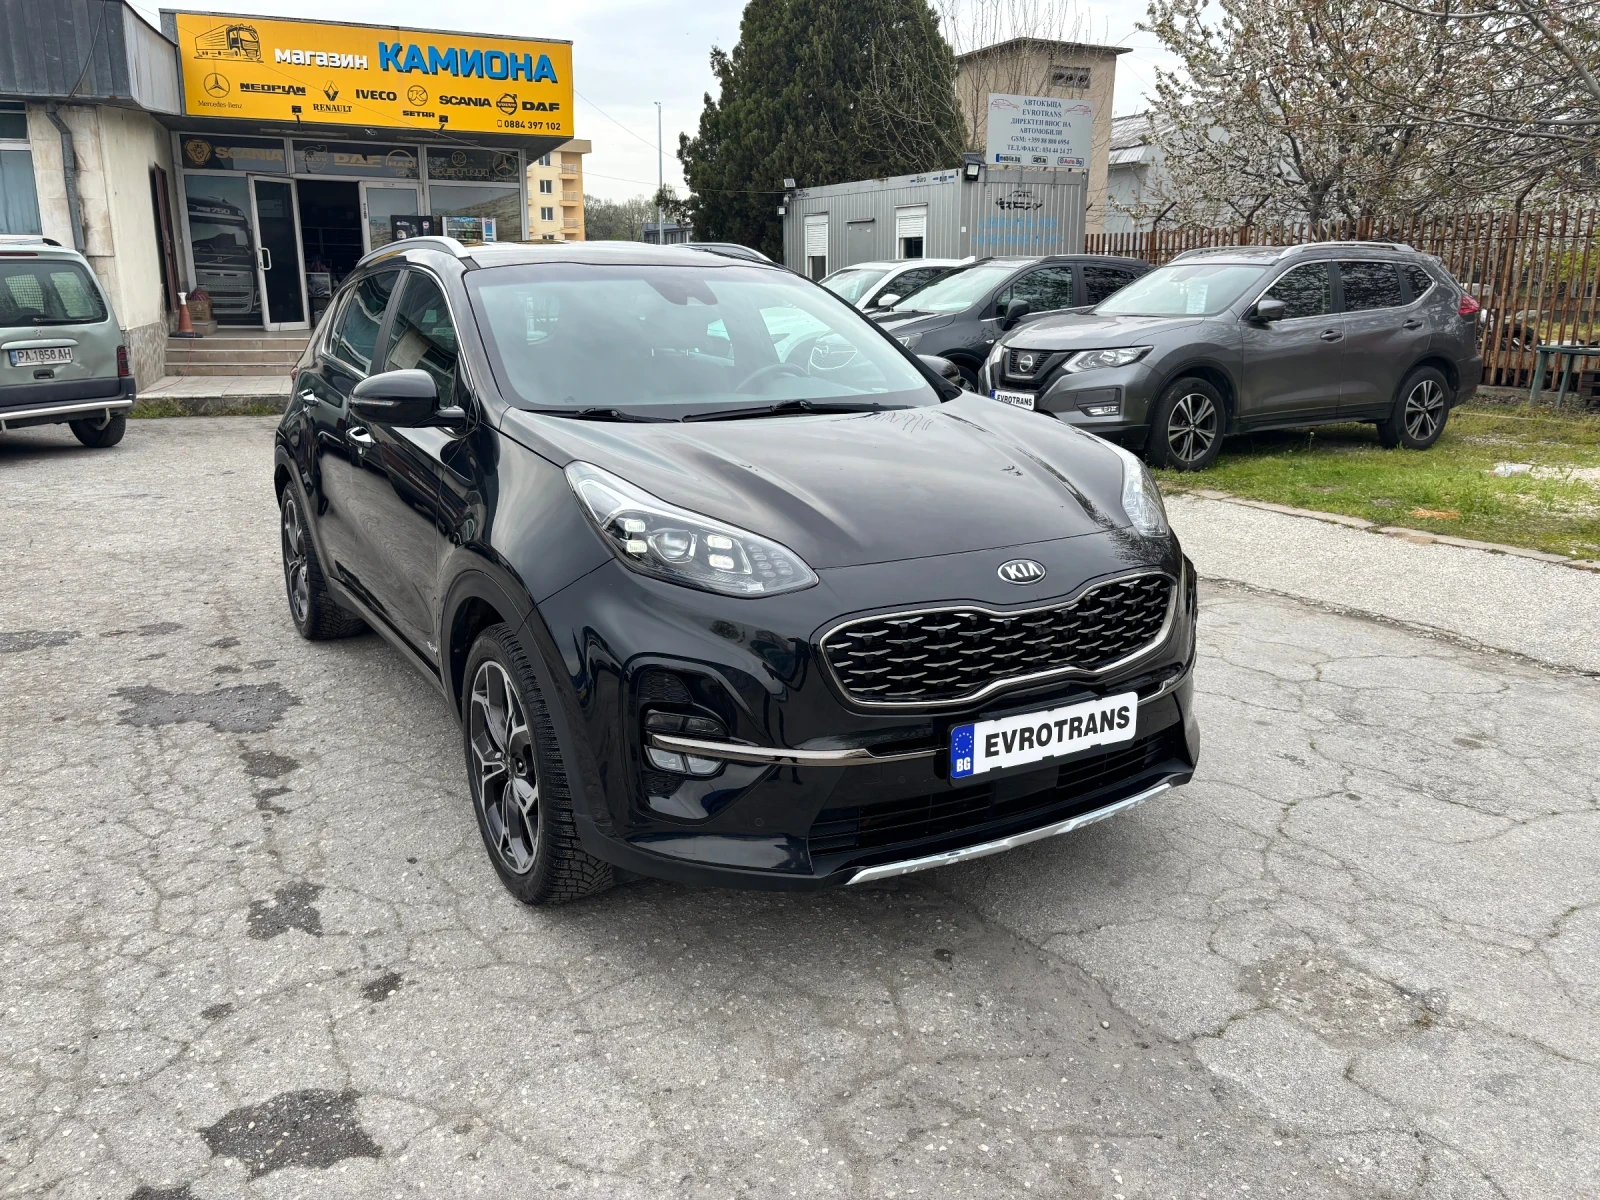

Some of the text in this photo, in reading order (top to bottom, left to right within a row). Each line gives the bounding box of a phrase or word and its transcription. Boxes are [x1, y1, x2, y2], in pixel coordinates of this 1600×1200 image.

[274, 41, 557, 82] магазин КАМИОНА
[240, 82, 306, 95] NEOPLAN
[356, 89, 397, 101] IVECO
[198, 100, 242, 109] Mercedes-Benz
[439, 95, 492, 107] SCANIA
[522, 101, 560, 112] DAF
[1023, 99, 1062, 108] АВТОКЪЩА
[313, 103, 352, 112] RENAULT
[1022, 109, 1062, 117] EVROTRANS
[403, 110, 435, 118] SETRA
[504, 120, 561, 131] 0884 397 102
[1010, 118, 1044, 126] ДИРЕКТЕН
[1044, 119, 1061, 127] ВНОС
[1020, 128, 1063, 136] АВТОМОБИЛИ
[215, 147, 284, 161] SCANIA
[334, 153, 381, 165] DAF
[1000, 154, 1021, 163] mobile.bg
[58, 348, 71, 359] AH
[997, 394, 1032, 406] EVROTRANS
[1005, 562, 1041, 580] KIA
[984, 706, 1130, 758] EVROTRANS
[956, 757, 971, 772] BG
